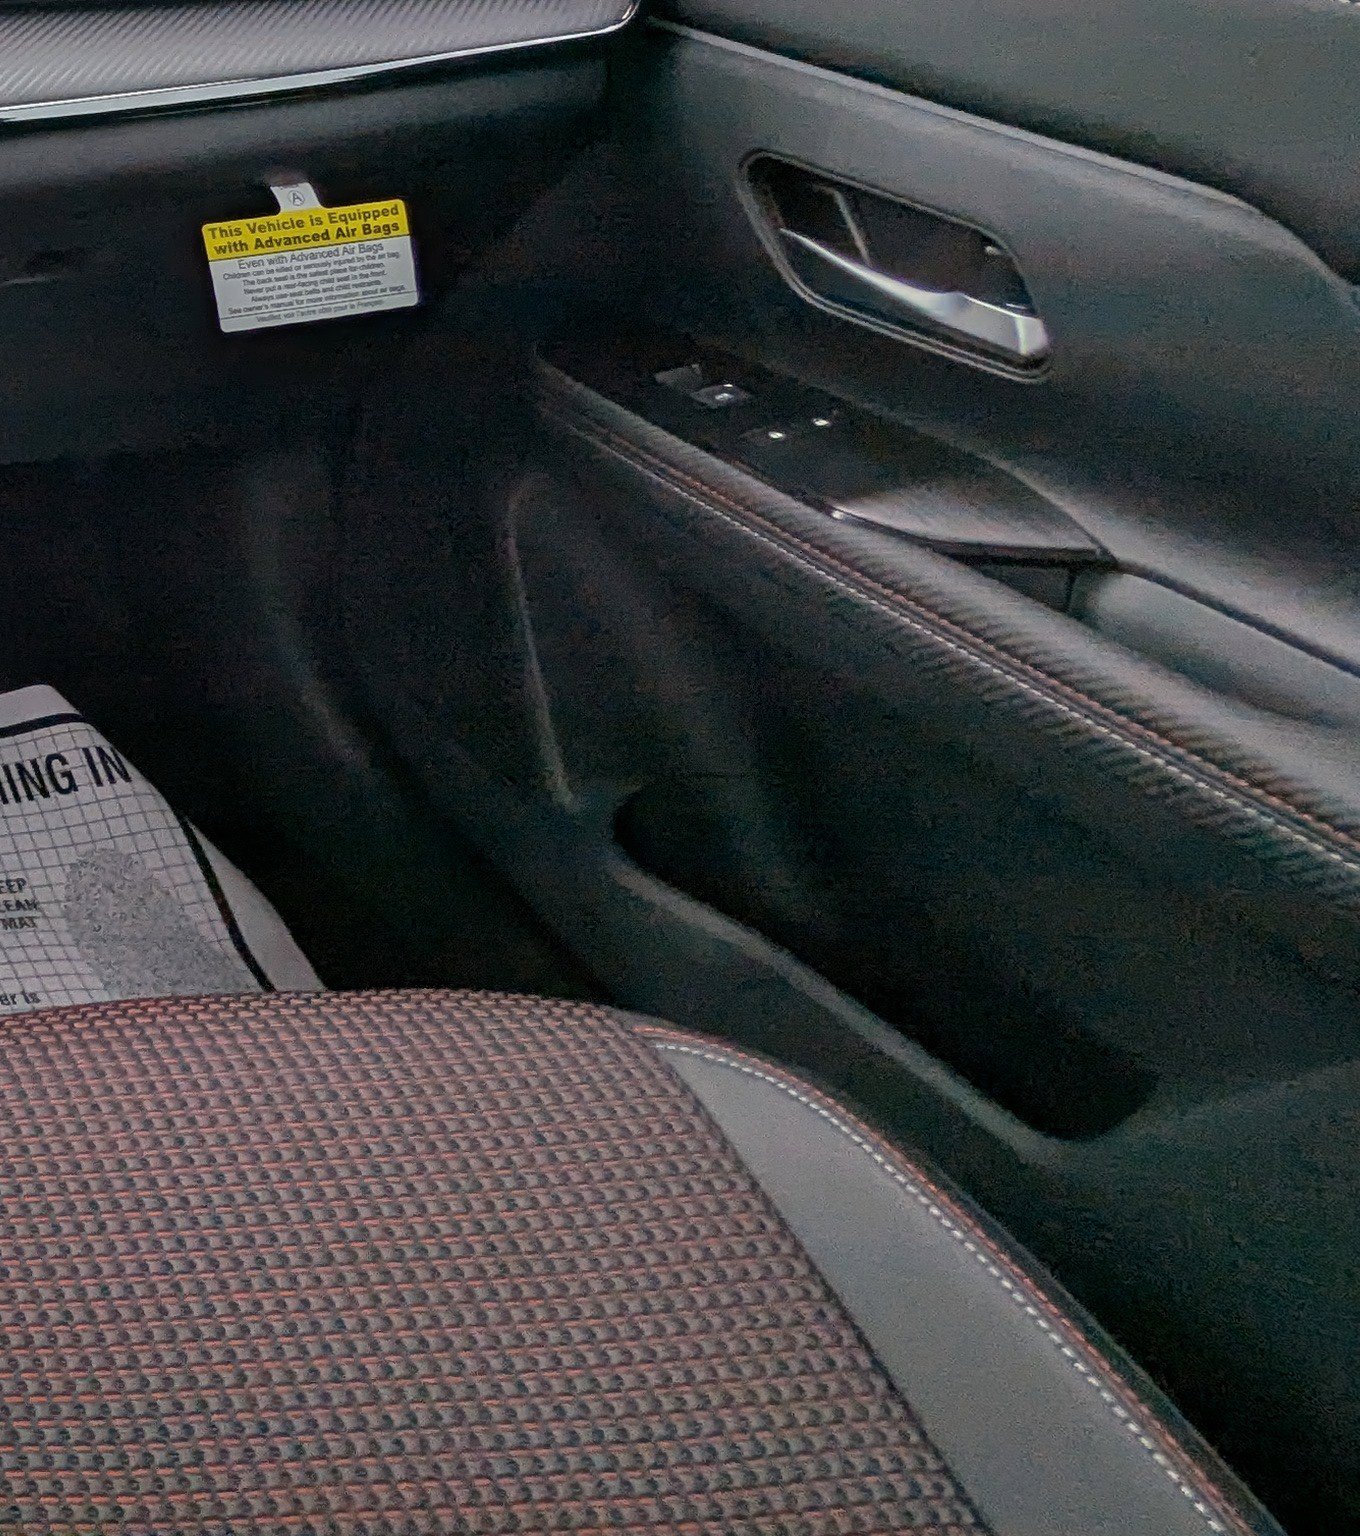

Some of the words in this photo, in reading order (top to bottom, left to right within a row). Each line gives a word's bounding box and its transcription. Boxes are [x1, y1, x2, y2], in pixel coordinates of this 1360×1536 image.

[291, 192, 302, 205] A
[209, 225, 242, 240] This
[247, 218, 305, 234] Vehicle
[310, 215, 323, 226] is
[328, 205, 399, 225] Equipped
[213, 241, 248, 255] with
[253, 230, 331, 250] Advanced
[335, 226, 357, 239] Air
[361, 220, 400, 237] Bags
[238, 259, 264, 270] Even
[266, 255, 288, 265] with
[290, 248, 339, 263] Advanced
[342, 244, 355, 255] Air
[358, 243, 384, 254] Bags
[223, 271, 251, 280] Children
[265, 285, 276, 293] put
[251, 294, 274, 303] Always
[243, 304, 269, 312] owner's
[83, 745, 131, 788] IN
[0, 916, 38, 930] MAT
[22, 991, 41, 1004] is
